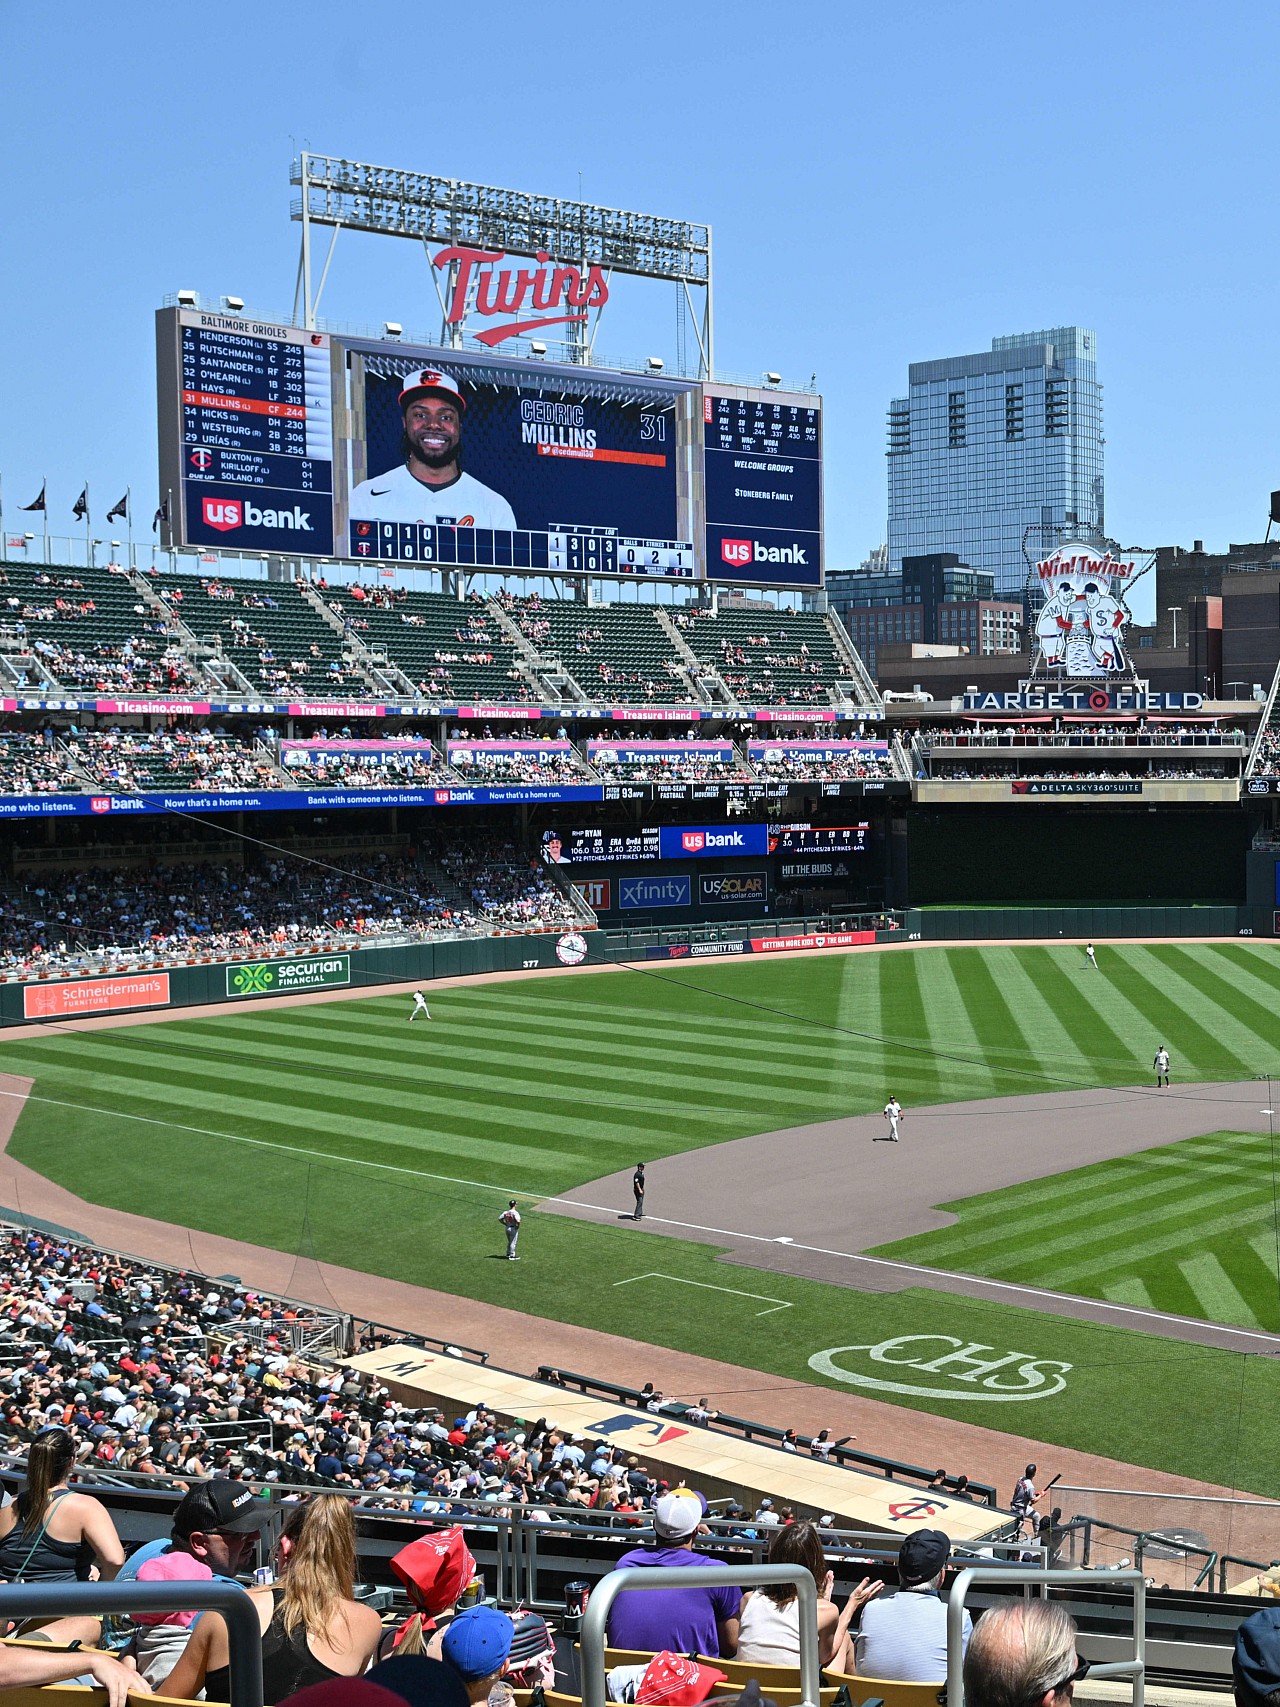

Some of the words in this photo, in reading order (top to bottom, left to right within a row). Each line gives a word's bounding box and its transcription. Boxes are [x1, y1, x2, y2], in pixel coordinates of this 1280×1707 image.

[434, 246, 609, 325] Twins
[201, 315, 250, 333] BALTIMORE
[252, 325, 287, 339] ORIOLES
[200, 331, 254, 347] HENDERSON
[200, 344, 254, 360] RUTSCHMAN
[200, 357, 254, 373] SANTANDER
[200, 370, 241, 383] O'HEARN
[201, 384, 224, 394] HAYS
[201, 396, 241, 409] MULLINS
[202, 409, 228, 420] HICKS
[520, 400, 584, 427] CEDRIC
[202, 422, 250, 435] WESTBURG
[641, 414, 666, 441] 31
[522, 422, 597, 450] MULLINS
[221, 452, 252, 462] BUXTON
[221, 463, 259, 473] KIRILLOFF
[734, 460, 766, 471] WELCOME
[767, 463, 794, 473] GROUPS
[221, 473, 252, 482] SOLANO
[771, 492, 793, 502] FAMILY
[206, 503, 239, 525] us
[725, 544, 749, 560] us
[1037, 556, 1077, 579] Win!
[1079, 553, 1135, 578] Twins!
[963, 693, 1085, 710] TARGET
[1116, 693, 1203, 710] FIELD
[299, 705, 344, 716] Treasure
[345, 706, 377, 717] Island
[622, 710, 662, 720] Treasure
[665, 710, 692, 720] Island
[165, 800, 185, 808] Now
[219, 798, 242, 806] home
[308, 796, 327, 805] Bank
[328, 795, 345, 804] with
[347, 796, 381, 804] someone
[382, 795, 398, 803] who
[399, 794, 424, 803] listens.
[436, 793, 448, 801] us
[92, 800, 109, 809] us
[585, 830, 601, 838] RYAN
[684, 836, 703, 847] us
[782, 865, 795, 875] HIT
[796, 865, 810, 874] THE
[811, 863, 832, 874] BUDS
[623, 881, 687, 905] xfinity
[762, 940, 785, 949] GETTING
[786, 939, 801, 948] MORE
[802, 939, 814, 947] KIDS
[827, 936, 836, 944] THE
[838, 935, 852, 944] GAME
[909, 932, 921, 940] 411
[668, 946, 688, 957] Twins
[691, 944, 727, 954] COMMUNITY
[728, 943, 744, 952] FUND
[278, 960, 343, 978] securian
[522, 960, 539, 968] 377
[278, 975, 325, 986] FINANCIAL
[62, 980, 161, 999] Schneiderman's
[64, 997, 109, 1007] FURNITURE
[870, 1334, 1074, 1390] CHS
